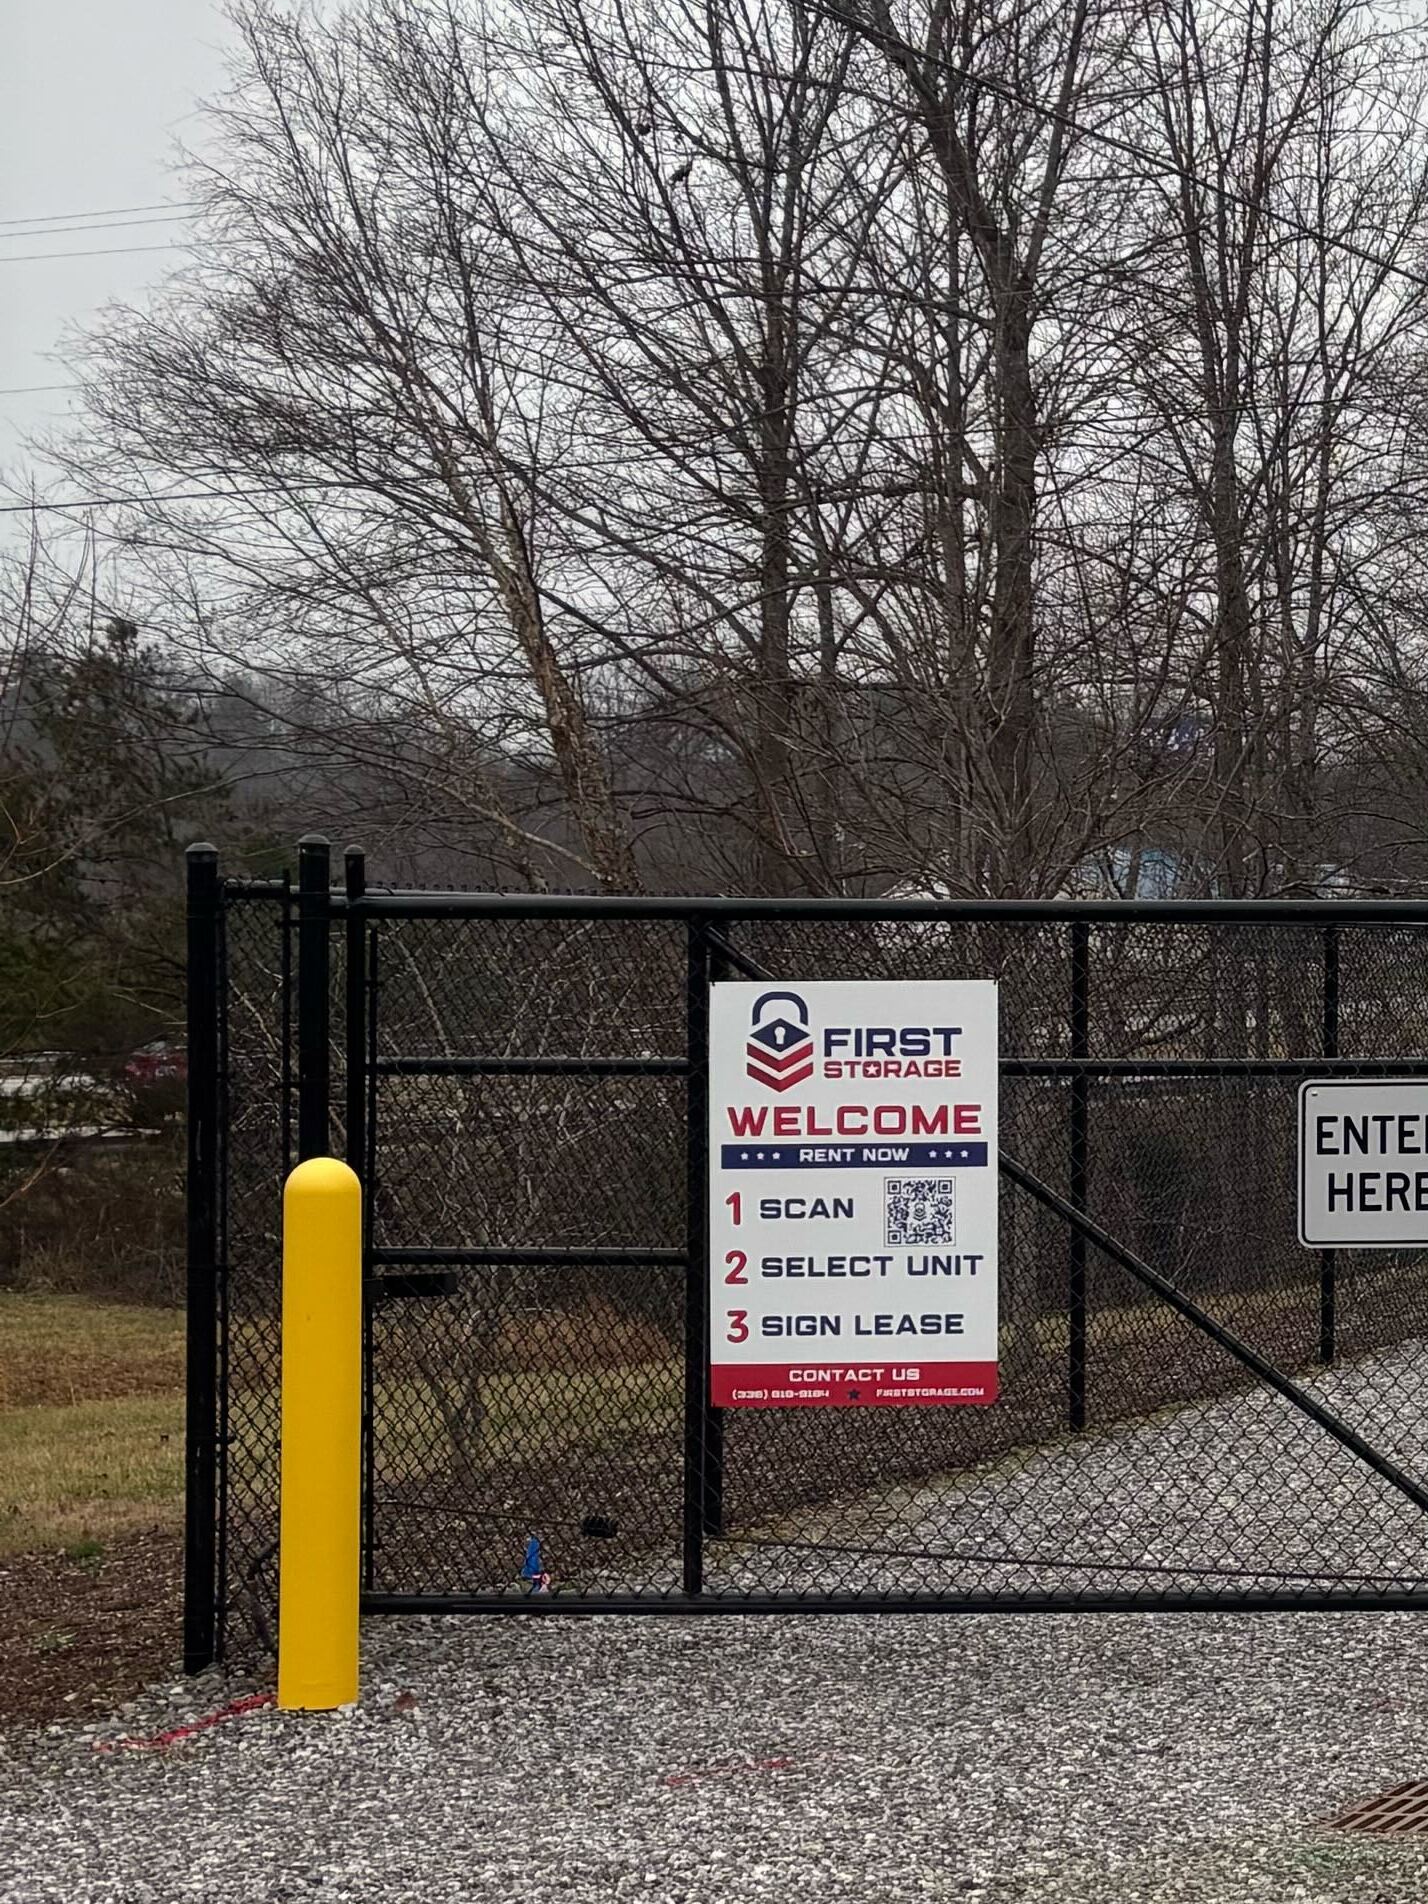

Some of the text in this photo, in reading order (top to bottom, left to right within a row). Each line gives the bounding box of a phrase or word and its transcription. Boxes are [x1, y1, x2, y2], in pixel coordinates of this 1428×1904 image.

[823, 1027, 962, 1057] FIRST
[823, 1060, 962, 1078] STORAGE
[728, 1104, 982, 1136] WELCOME
[800, 1147, 910, 1162] RENT NOW
[726, 1192, 853, 1225] 1 SCAN
[725, 1250, 984, 1284] 2 SELECT UNIT
[727, 1310, 964, 1343] 3 SIGN LEASE
[789, 1368, 920, 1382] CONTACT US
[876, 1387, 985, 1397] FIRSTSTORAGE.COM
